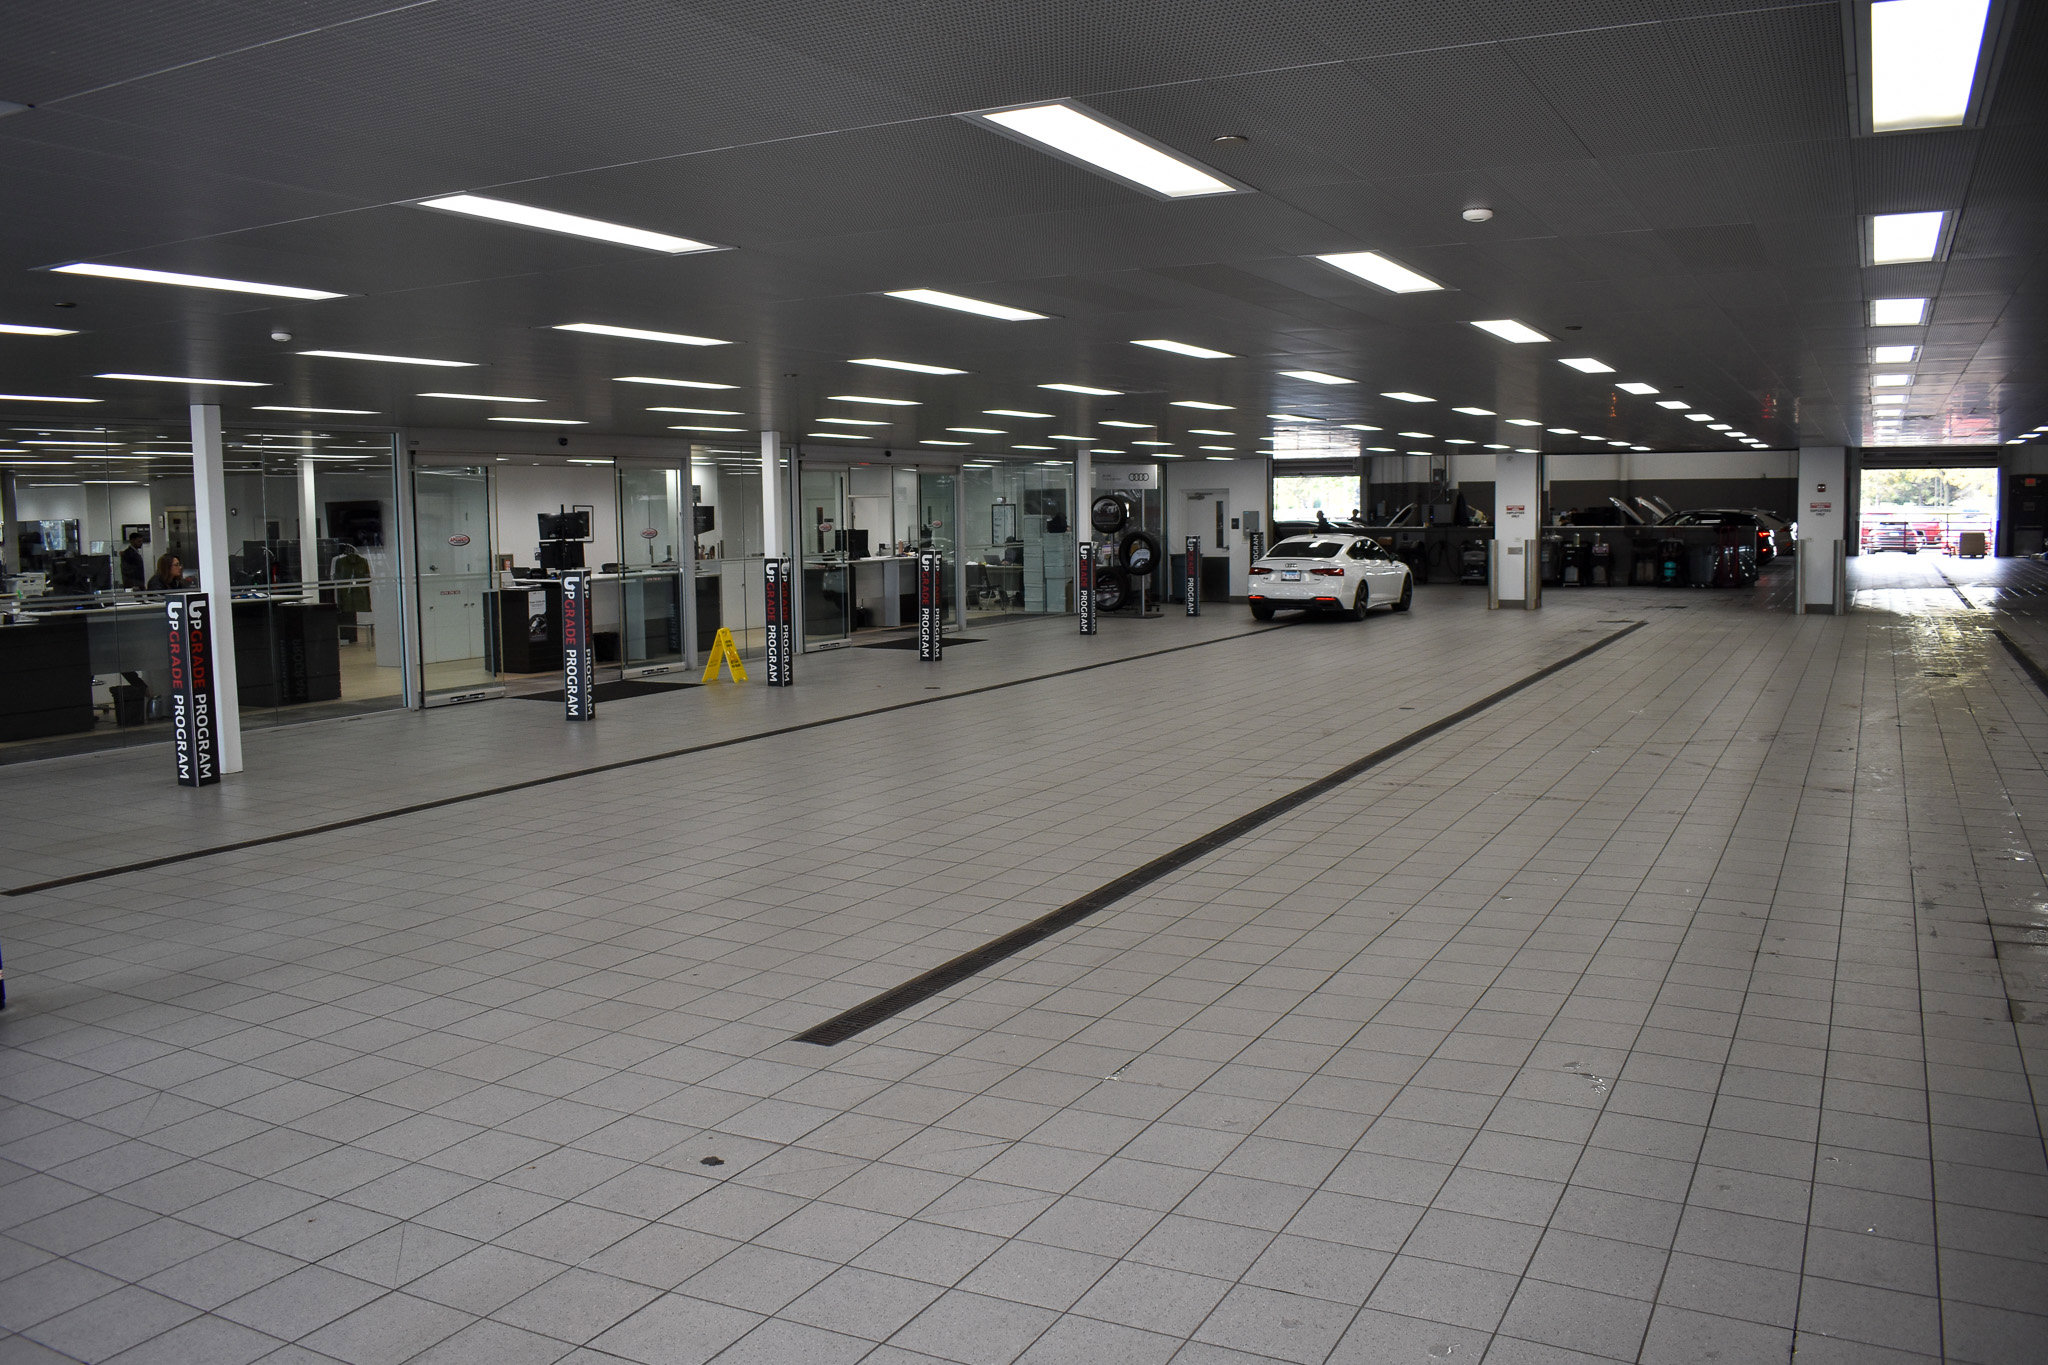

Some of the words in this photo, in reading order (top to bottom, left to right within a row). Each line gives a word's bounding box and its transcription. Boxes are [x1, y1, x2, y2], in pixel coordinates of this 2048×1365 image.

[564, 576, 580, 646] UPGRADE
[766, 562, 778, 621] UPGRADE
[922, 554, 932, 606] UPGRADE
[168, 602, 183, 689] UPGRADE
[189, 600, 206, 689] UPGRADE
[768, 624, 778, 682] PROGRAM
[922, 608, 930, 658] PROGRAM
[566, 649, 579, 716] PROGRAM
[174, 694, 190, 779] PROGRAM
[196, 694, 212, 779] PROGRAM
